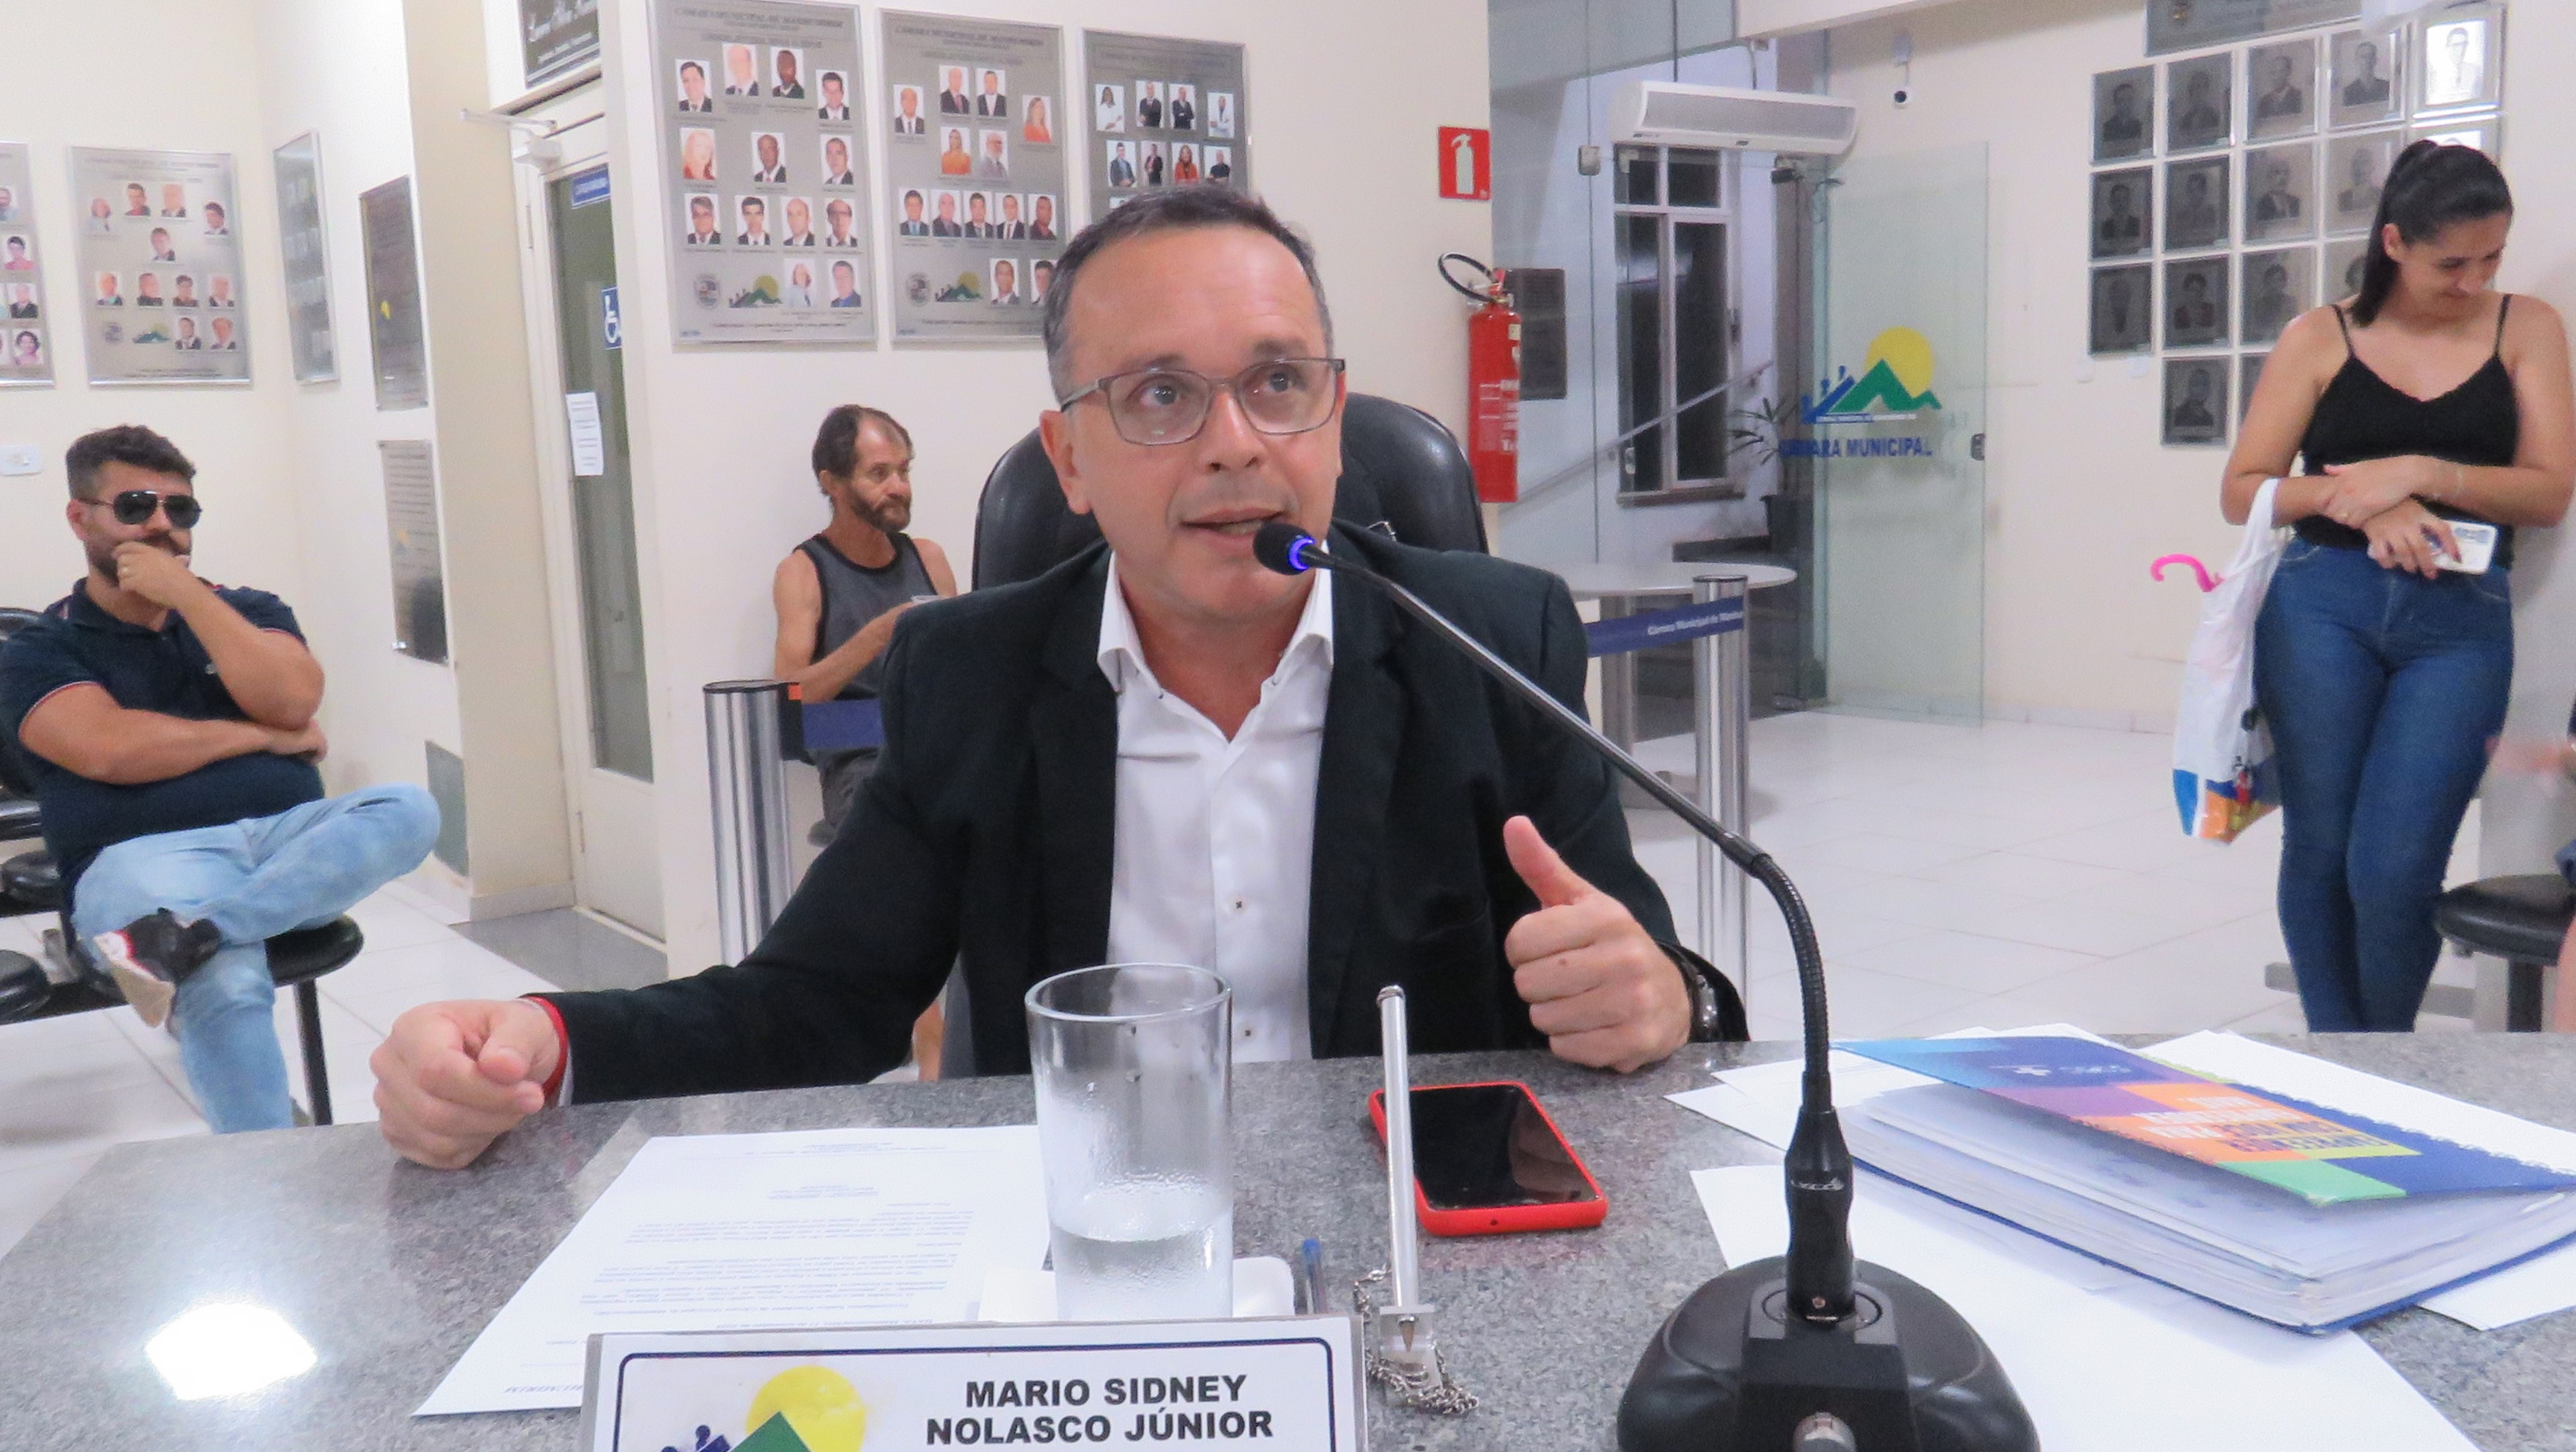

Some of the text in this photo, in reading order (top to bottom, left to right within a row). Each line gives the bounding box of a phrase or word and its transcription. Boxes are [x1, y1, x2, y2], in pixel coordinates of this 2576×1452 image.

[965, 1374, 1247, 1407] MARIO SIDNEY
[927, 1407, 1273, 1445] NOLASCO JÚNIOR
